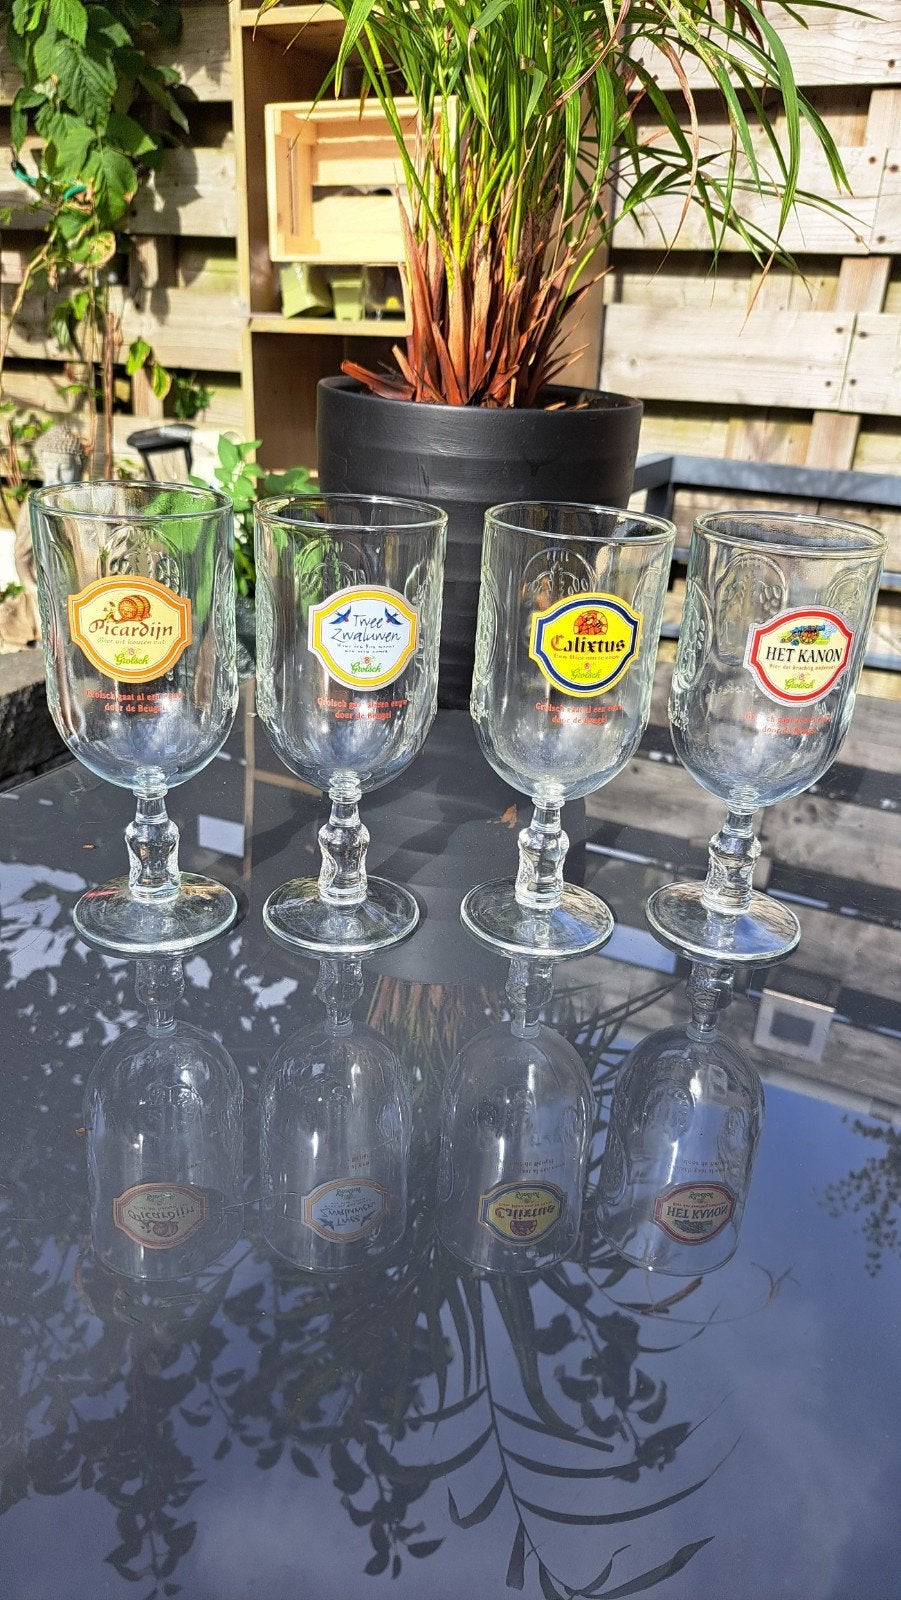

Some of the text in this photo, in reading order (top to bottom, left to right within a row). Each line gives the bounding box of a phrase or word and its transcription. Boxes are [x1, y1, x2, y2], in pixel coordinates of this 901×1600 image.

[353, 614, 384, 629] Twee
[88, 619, 173, 640] Picardijn
[331, 628, 402, 643] Zwaluwen
[551, 634, 625, 653] Calixtus
[114, 653, 149, 666] Grolsch
[765, 646, 843, 663] HET KANON
[351, 661, 383, 675] Grolsch
[570, 668, 602, 680] Grolsch
[784, 678, 816, 690] Grolsch
[137, 692, 145, 701] al
[126, 703, 136, 712] de
